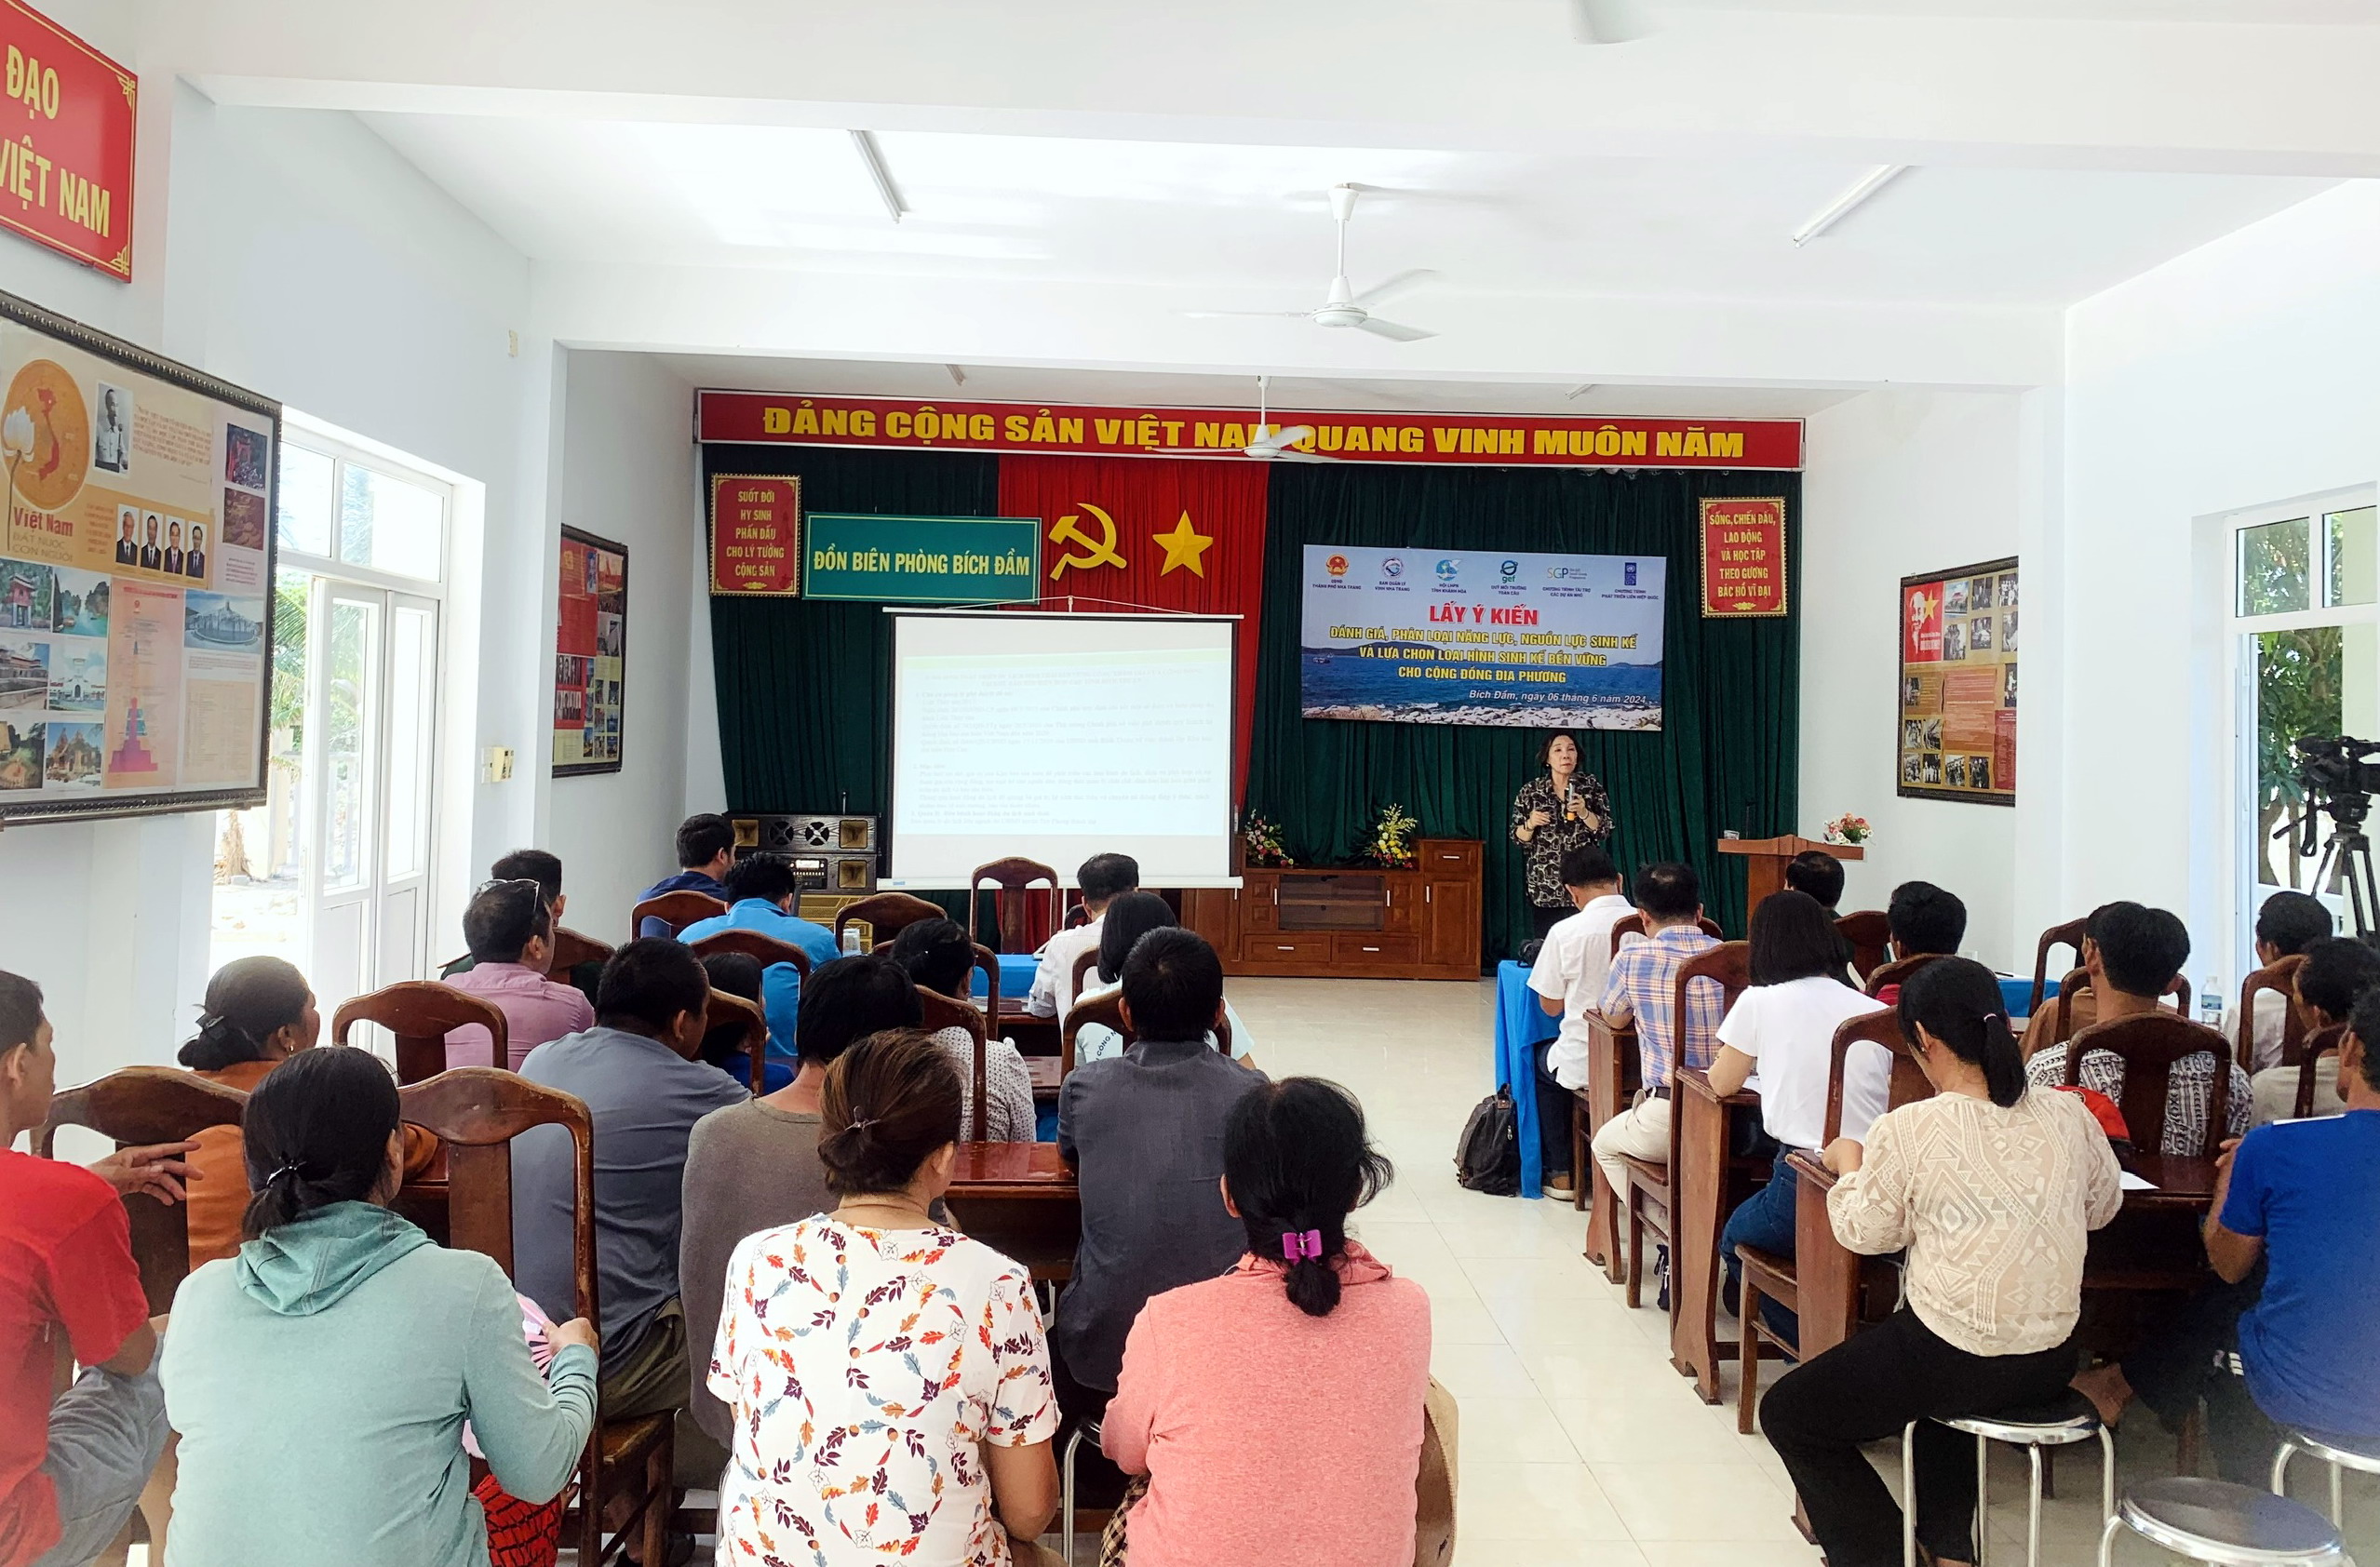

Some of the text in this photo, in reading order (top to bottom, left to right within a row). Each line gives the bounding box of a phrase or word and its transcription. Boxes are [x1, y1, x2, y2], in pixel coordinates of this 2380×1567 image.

[6, 45, 60, 120] ĐẠO
[60, 167, 110, 238] NAM
[762, 399, 878, 436] ĐẢNG
[884, 406, 996, 446] CỘNG
[1004, 408, 1084, 445] SẢN
[1095, 413, 1186, 451] VIỆT
[1292, 425, 1425, 455] QUANG
[1435, 427, 1525, 456] VINH
[1534, 424, 1648, 458] MUÔN
[1656, 425, 1744, 459] NĂM
[738, 488, 774, 502] SUỐT ĐỜI
[13, 507, 74, 537] Việt Nam
[741, 509, 772, 520] HY SINH
[1710, 510, 1776, 527] SỐNG, CHIẾN ĐẤU,
[735, 524, 758, 539] PHẤN
[1724, 529, 1762, 545] LAO ĐỘNG
[727, 542, 785, 558] CHO LÝ TƯỞNG
[1721, 548, 1766, 563] VÀ HỌC TẬP
[814, 542, 1029, 576] ĐỒN BIÊN PHÒNG BÍCH ĐẦM
[735, 561, 775, 578] CỘNG SẢN
[1547, 568, 1568, 579] SGP
[1719, 568, 1768, 579] THEO GƯƠNG
[1502, 575, 1515, 583] gef
[1718, 584, 1733, 597] BÁC
[1749, 583, 1756, 597] VĨ
[1757, 586, 1770, 599] ĐẠI
[1430, 600, 1540, 626] LẤY Ý KIẾN
[1330, 625, 1363, 638] ĐÁNH
[1365, 626, 1388, 641] GIÁ,
[1392, 628, 1423, 641] PHÂN
[1427, 630, 1453, 644] LOẠI
[1457, 629, 1489, 643] NĂNG
[1492, 632, 1517, 646] LỰC,
[1565, 634, 1587, 650] LỰC
[1590, 636, 1619, 649] SINH
[1621, 634, 1638, 650] KẾ
[1360, 645, 1374, 658] VÀ
[1378, 647, 1399, 661] LỰA
[1404, 649, 1434, 662] CHỌN
[1438, 650, 1463, 663] LOẠI
[1467, 648, 1495, 662] HÌNH
[1499, 651, 1526, 663] SINH
[1530, 650, 1546, 663] KẾ
[1576, 652, 1607, 666] VỮNG
[1398, 666, 1422, 677] CHO
[1425, 665, 1457, 681] CỘNG
[1496, 670, 1515, 684] ĐỊA
[1519, 670, 1566, 683] PHƯƠNG
[1469, 690, 1491, 699] Bích
[1521, 691, 1545, 702] ngày
[1561, 693, 1589, 703] tháng
[1600, 694, 1620, 703] năm
[1623, 695, 1647, 703] 2024
